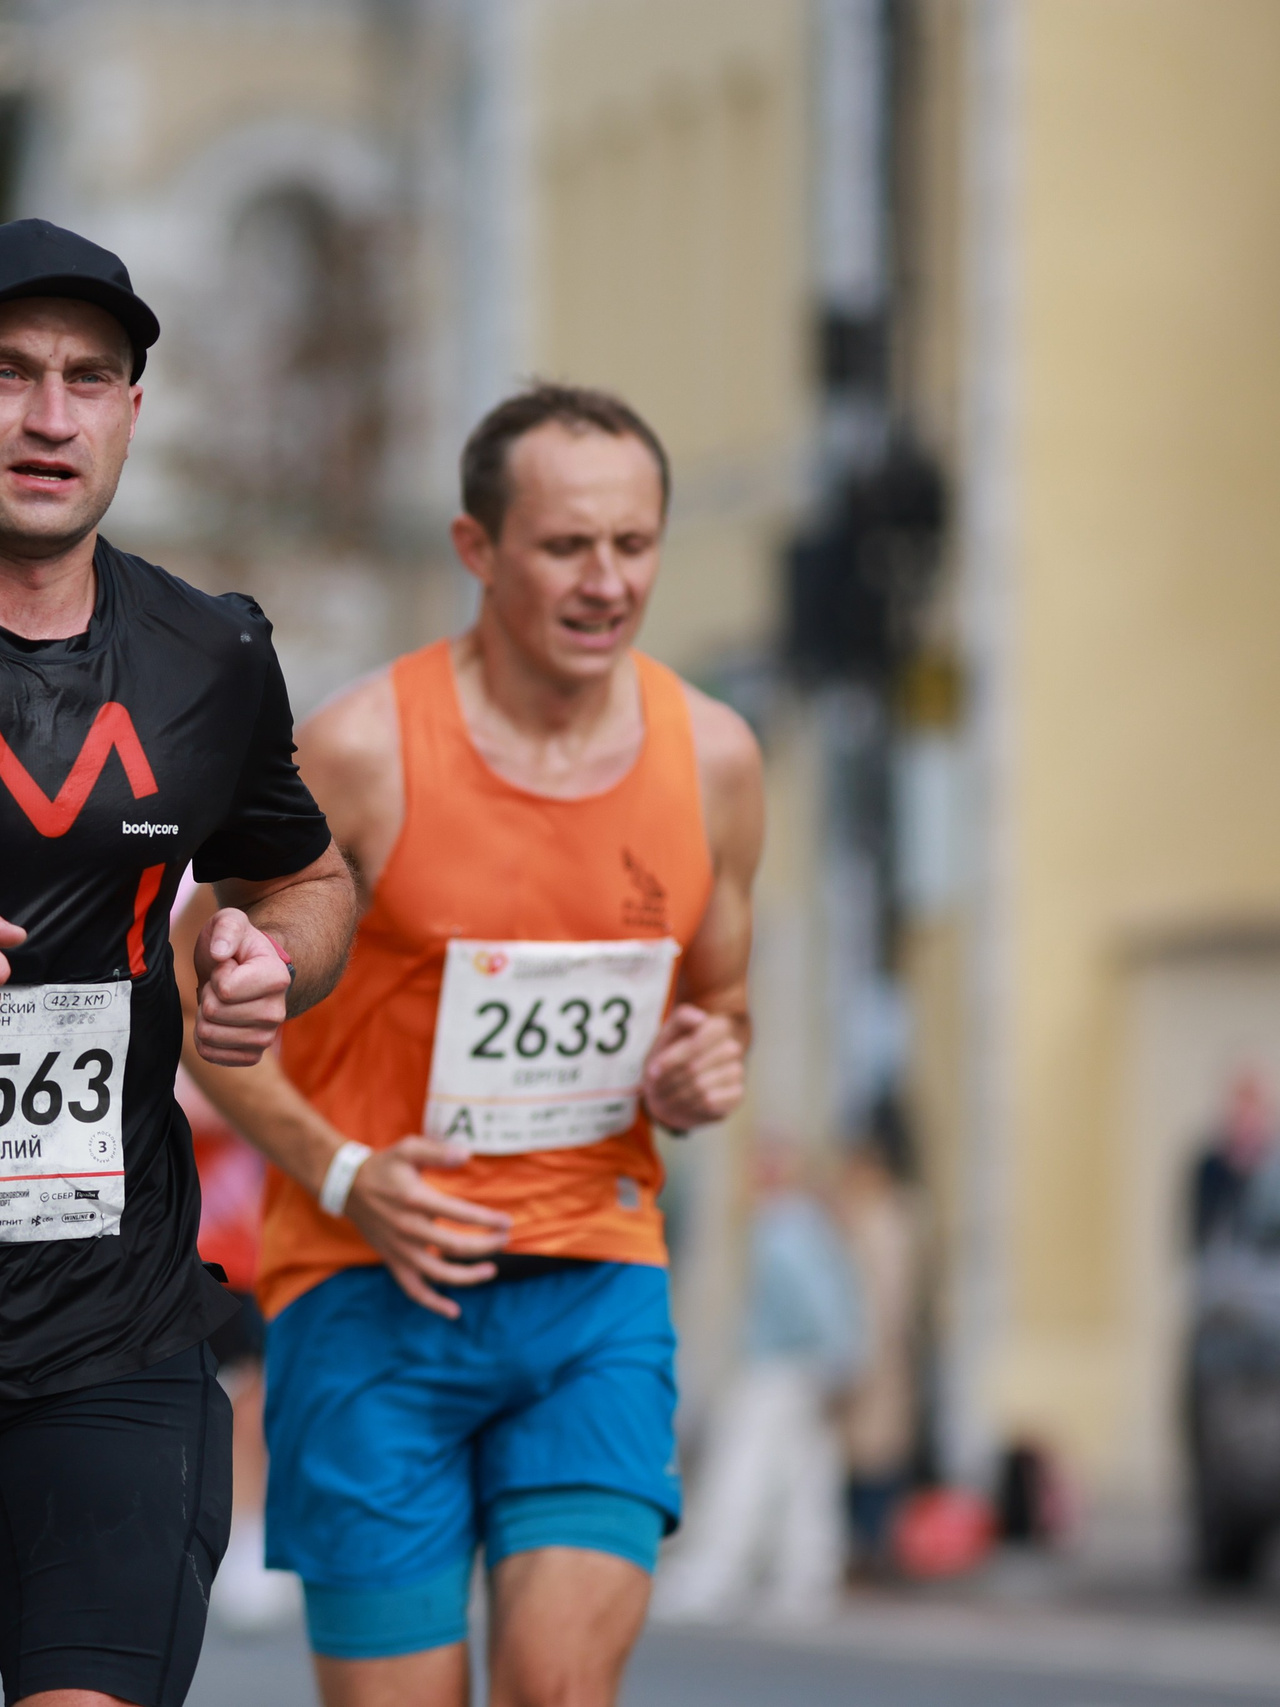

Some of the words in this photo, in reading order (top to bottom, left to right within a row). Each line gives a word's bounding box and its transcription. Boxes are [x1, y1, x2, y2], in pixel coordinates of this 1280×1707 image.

[122, 820, 179, 838] bodycore
[51, 995, 80, 1008] 42,2
[469, 997, 633, 1059] 2633
[98, 1140, 108, 1153] 3
[51, 1192, 74, 1200] СБЕР
